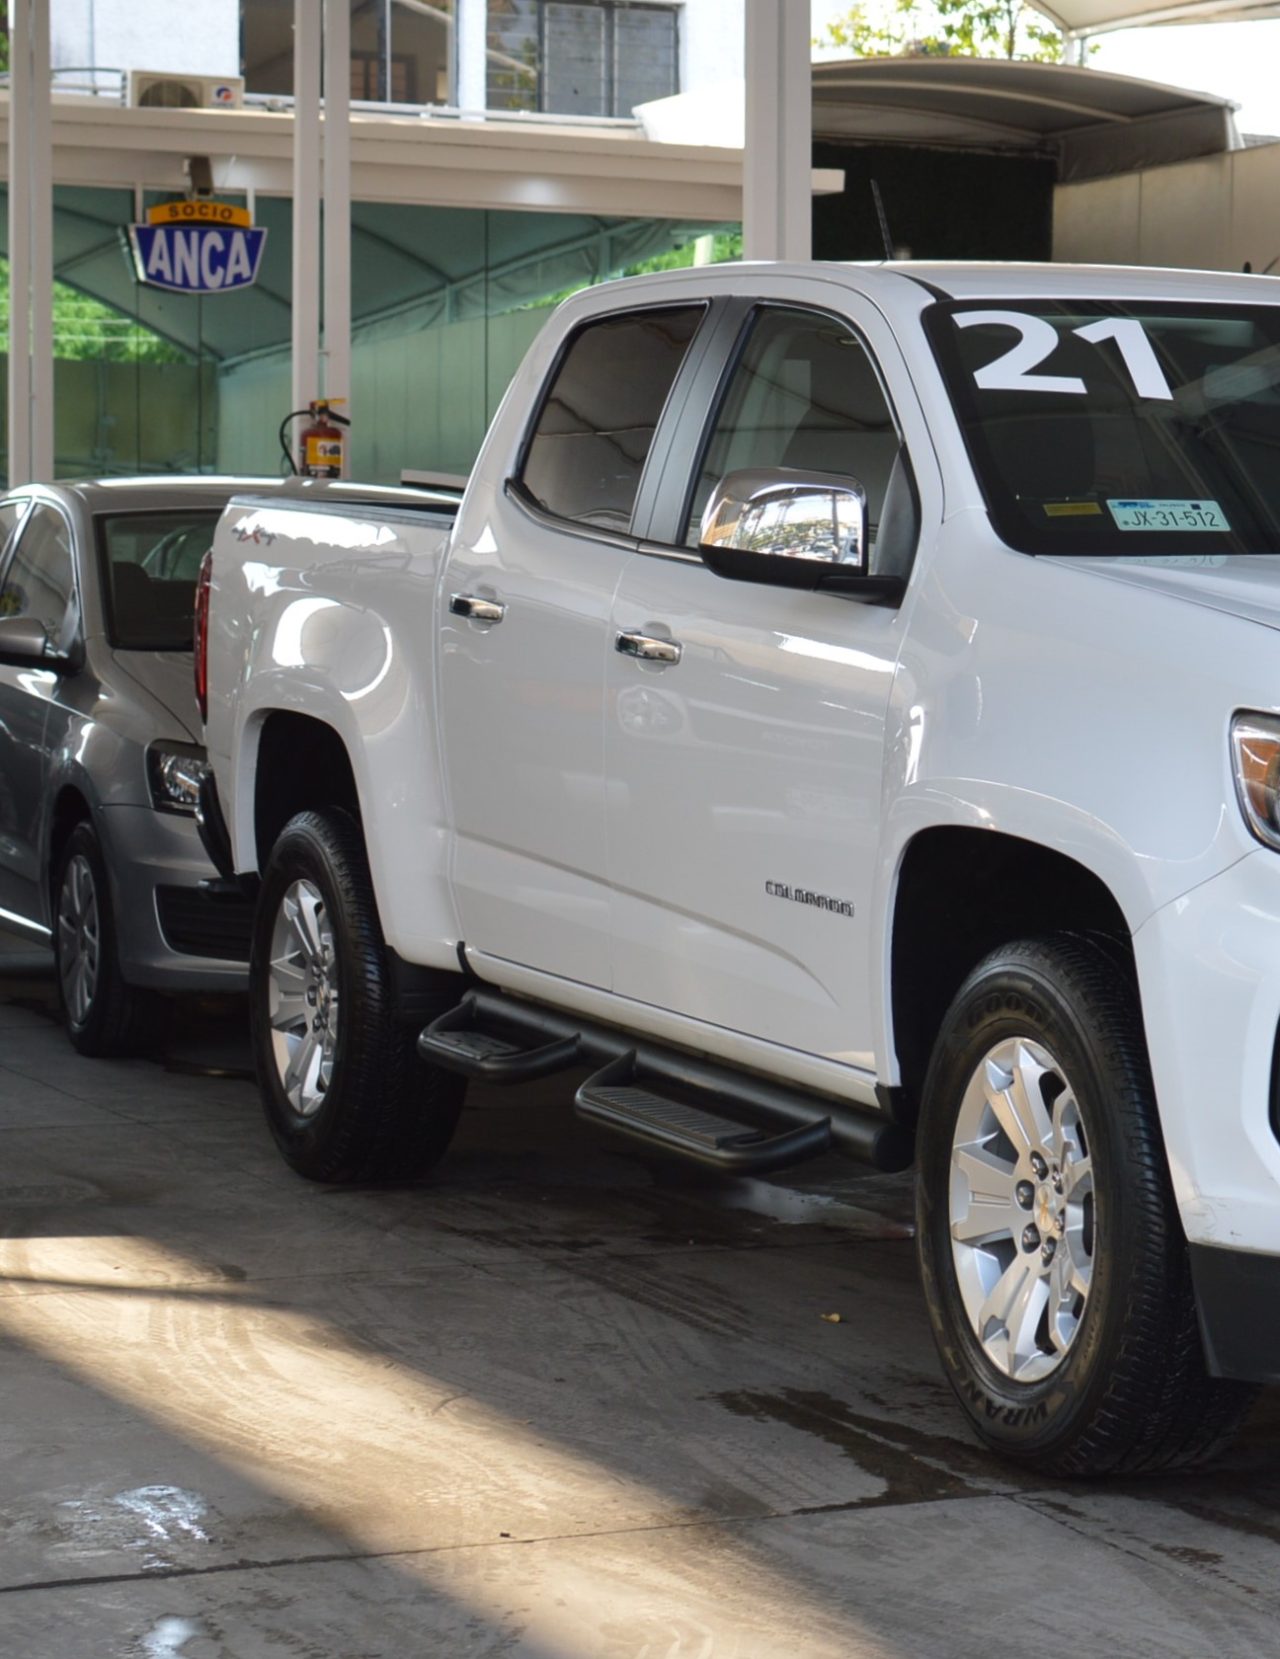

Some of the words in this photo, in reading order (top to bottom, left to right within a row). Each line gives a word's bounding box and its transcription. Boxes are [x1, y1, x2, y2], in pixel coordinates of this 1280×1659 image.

[168, 203, 234, 222] SOCIO
[147, 228, 252, 290] ANCA
[951, 309, 1174, 401] 21
[1131, 510, 1220, 528] JX-31-512
[765, 879, 855, 918] COLORADO
